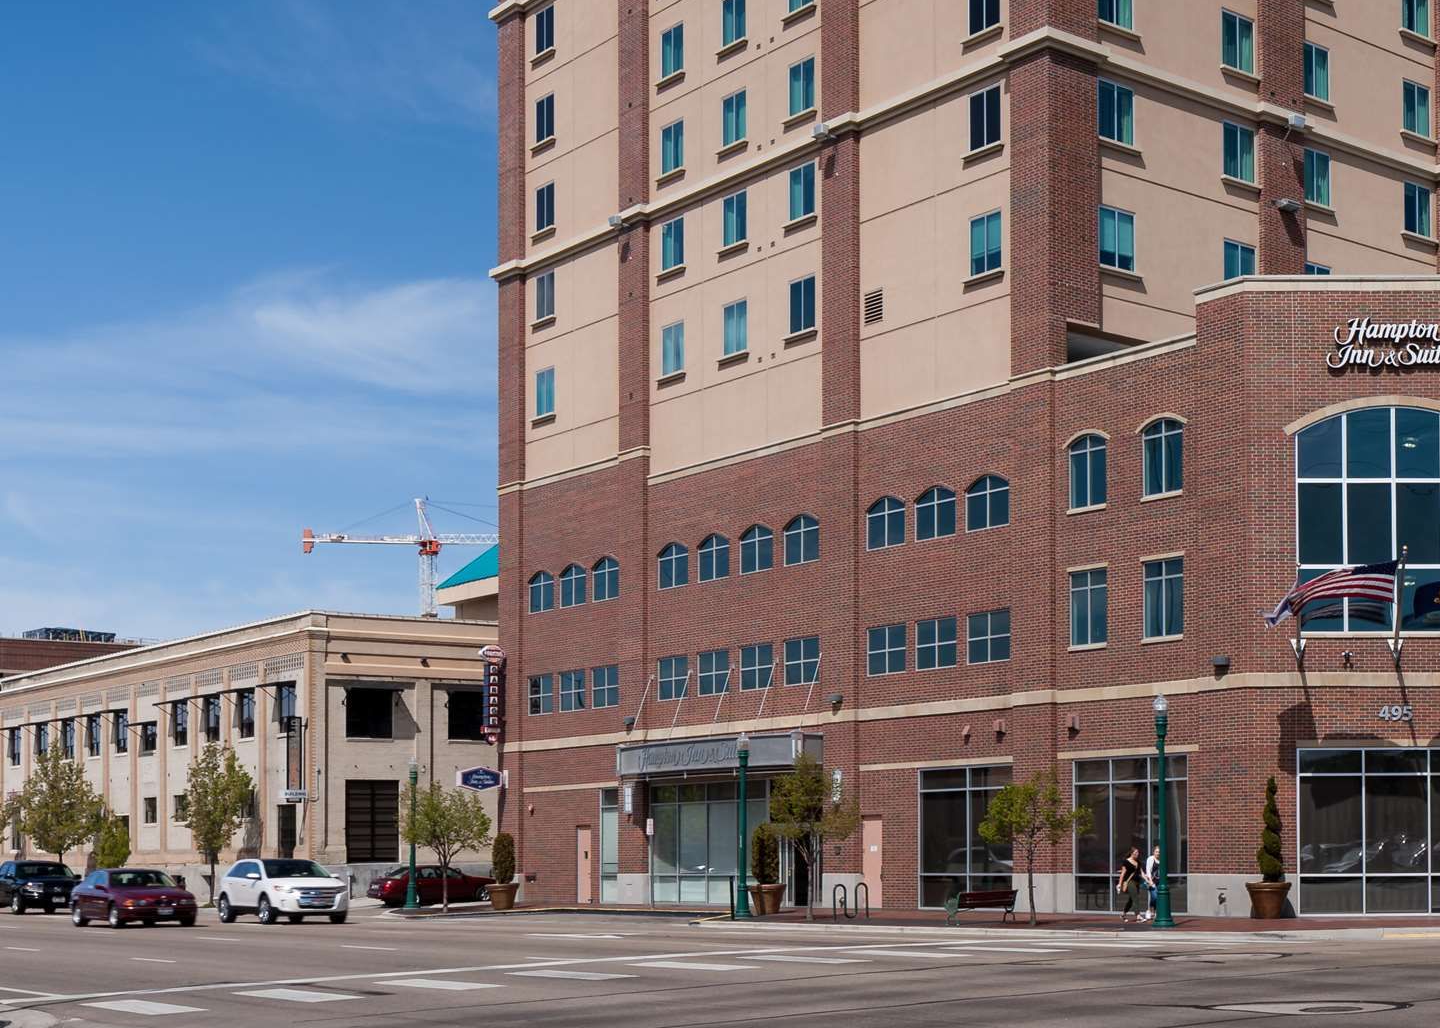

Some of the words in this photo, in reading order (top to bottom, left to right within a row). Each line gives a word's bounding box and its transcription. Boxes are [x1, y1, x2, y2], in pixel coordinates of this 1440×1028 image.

[1326, 345, 1385, 368] Inn
[1384, 349, 1400, 367] &
[1378, 705, 1413, 721] 495
